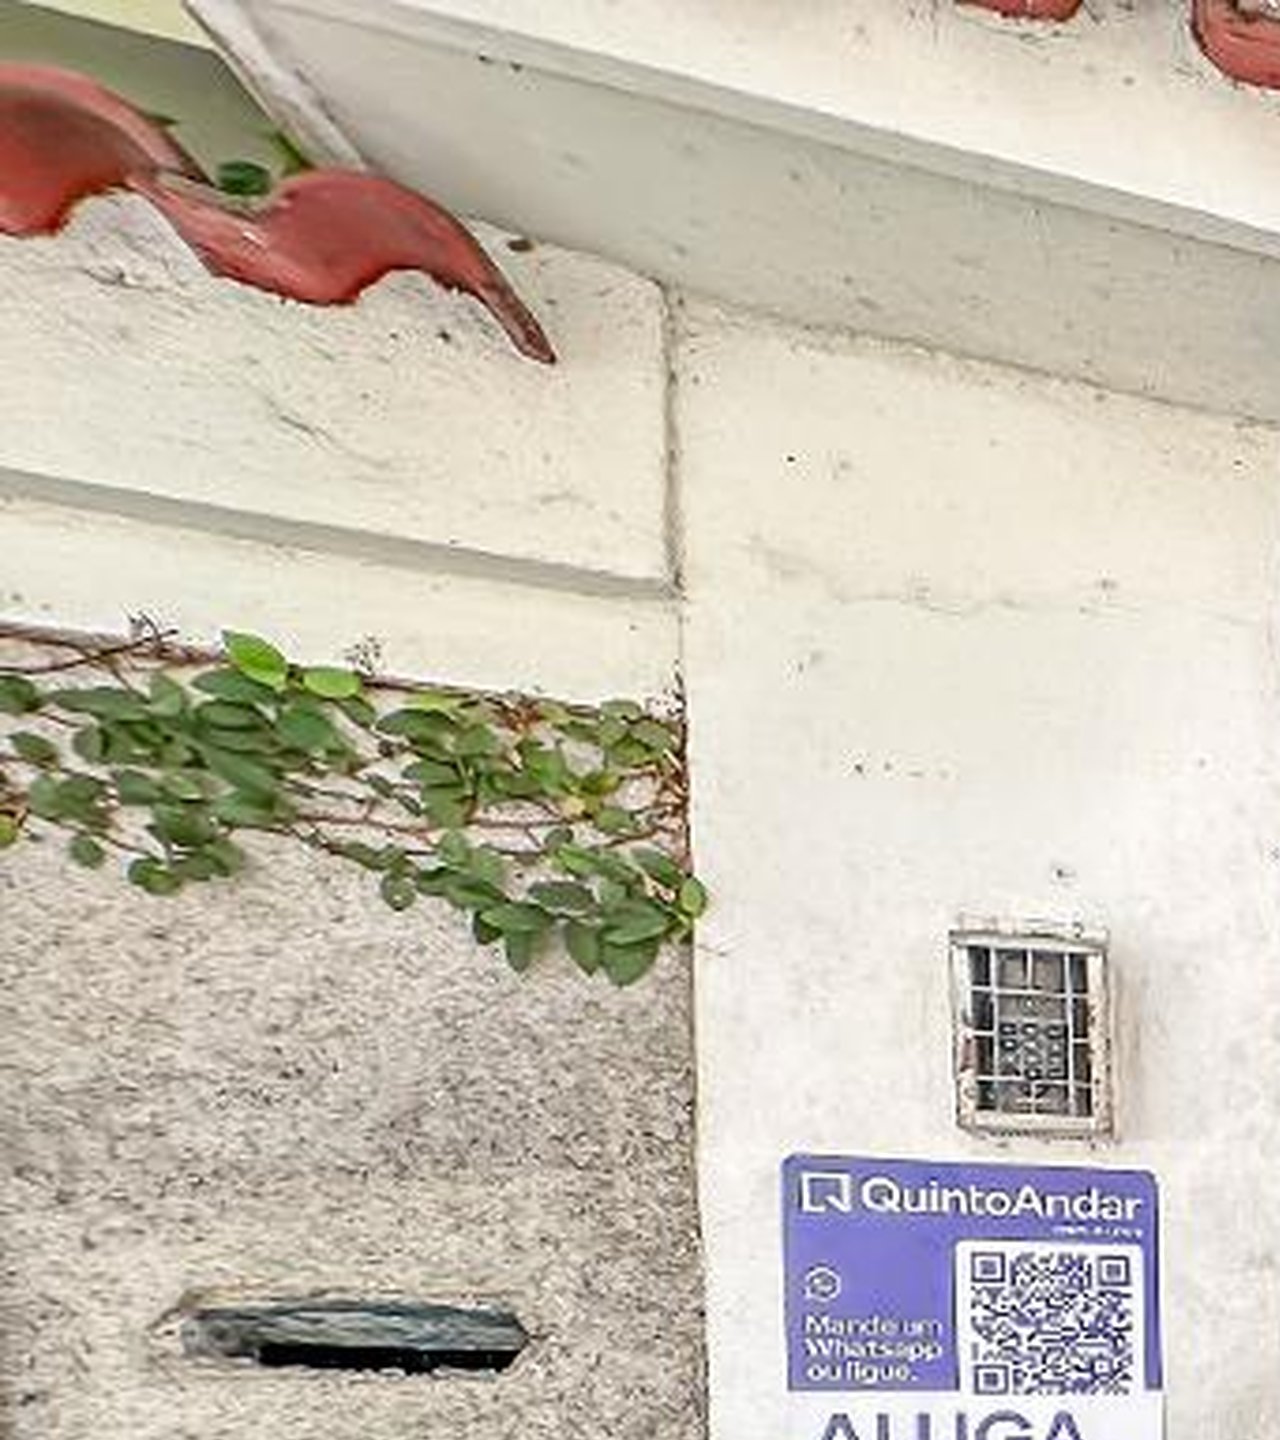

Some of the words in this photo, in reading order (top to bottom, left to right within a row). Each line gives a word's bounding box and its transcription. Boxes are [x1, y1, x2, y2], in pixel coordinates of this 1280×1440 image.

[862, 1177, 1143, 1221] QuintoAndar
[806, 1314, 898, 1337] Mande
[903, 1319, 943, 1338] um
[807, 1363, 841, 1382] ou
